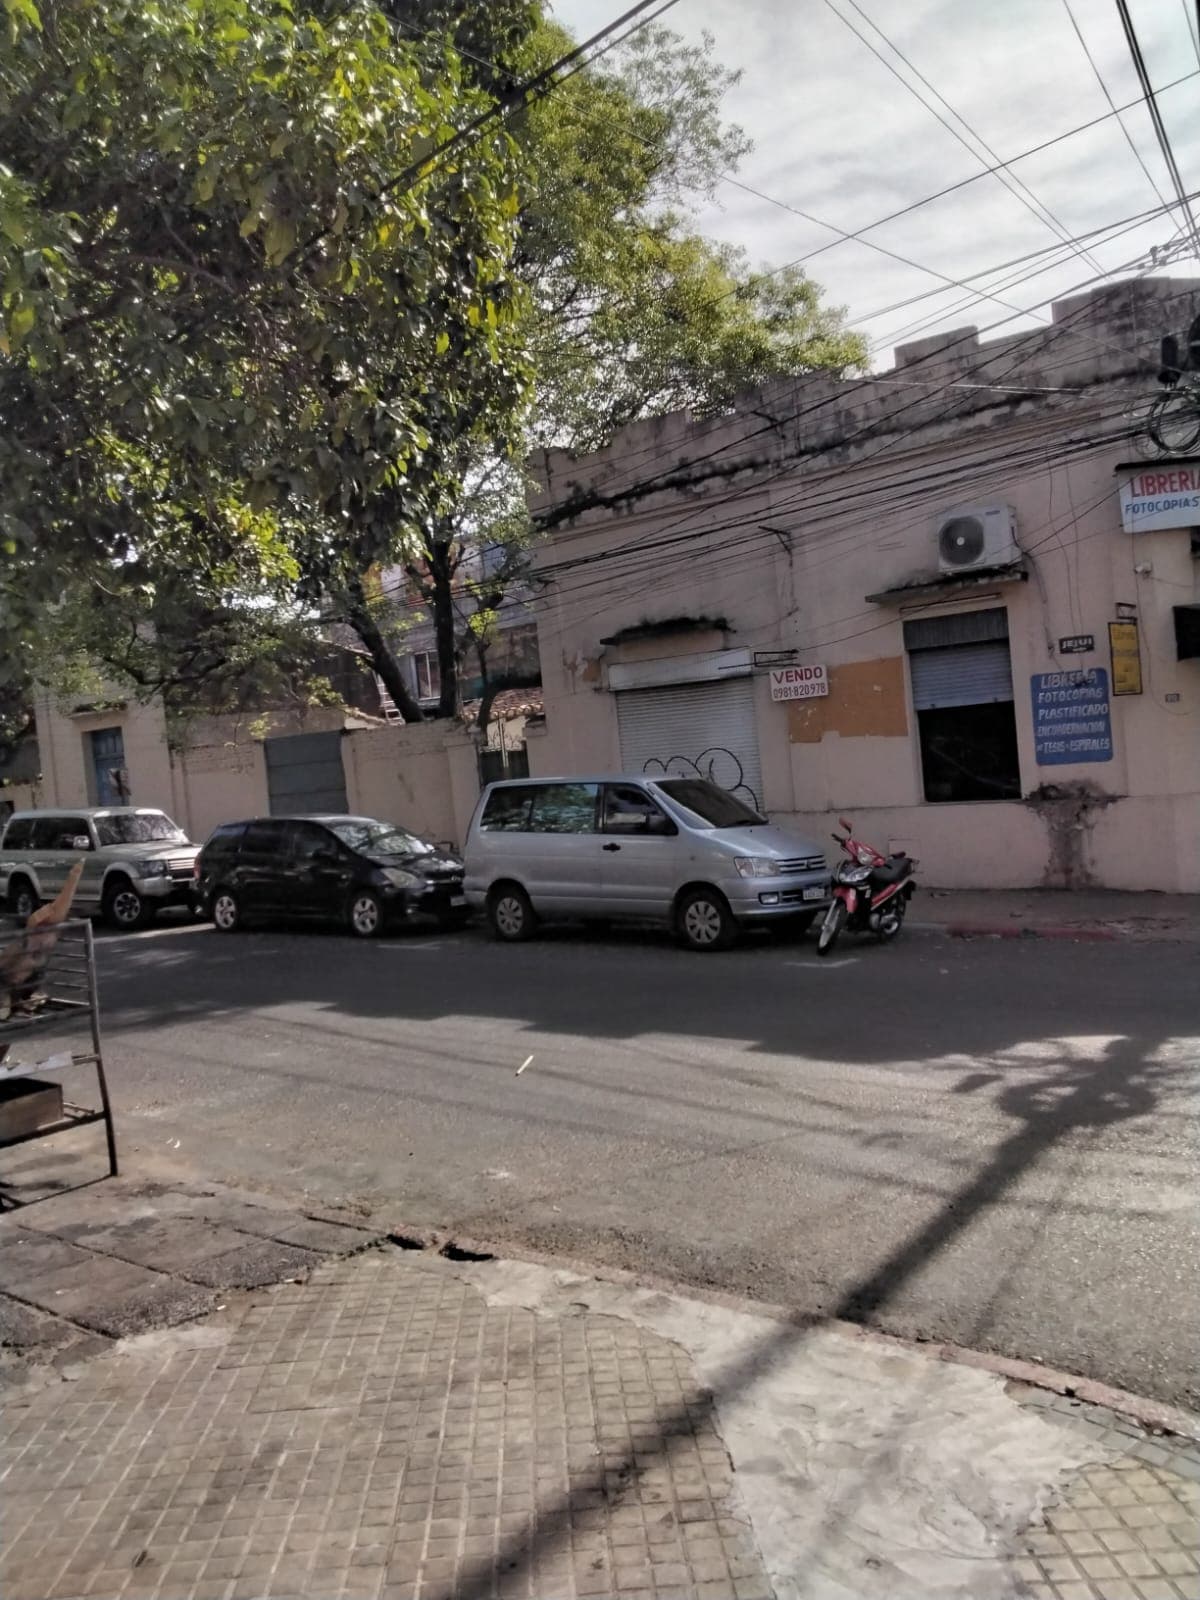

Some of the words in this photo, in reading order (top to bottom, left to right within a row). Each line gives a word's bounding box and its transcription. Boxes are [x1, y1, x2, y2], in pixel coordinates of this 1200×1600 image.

[1125, 496, 1200, 514] FOTOCOPIAS
[773, 666, 823, 684] VENDO
[1038, 703, 1109, 721] PLASTIFICADO
